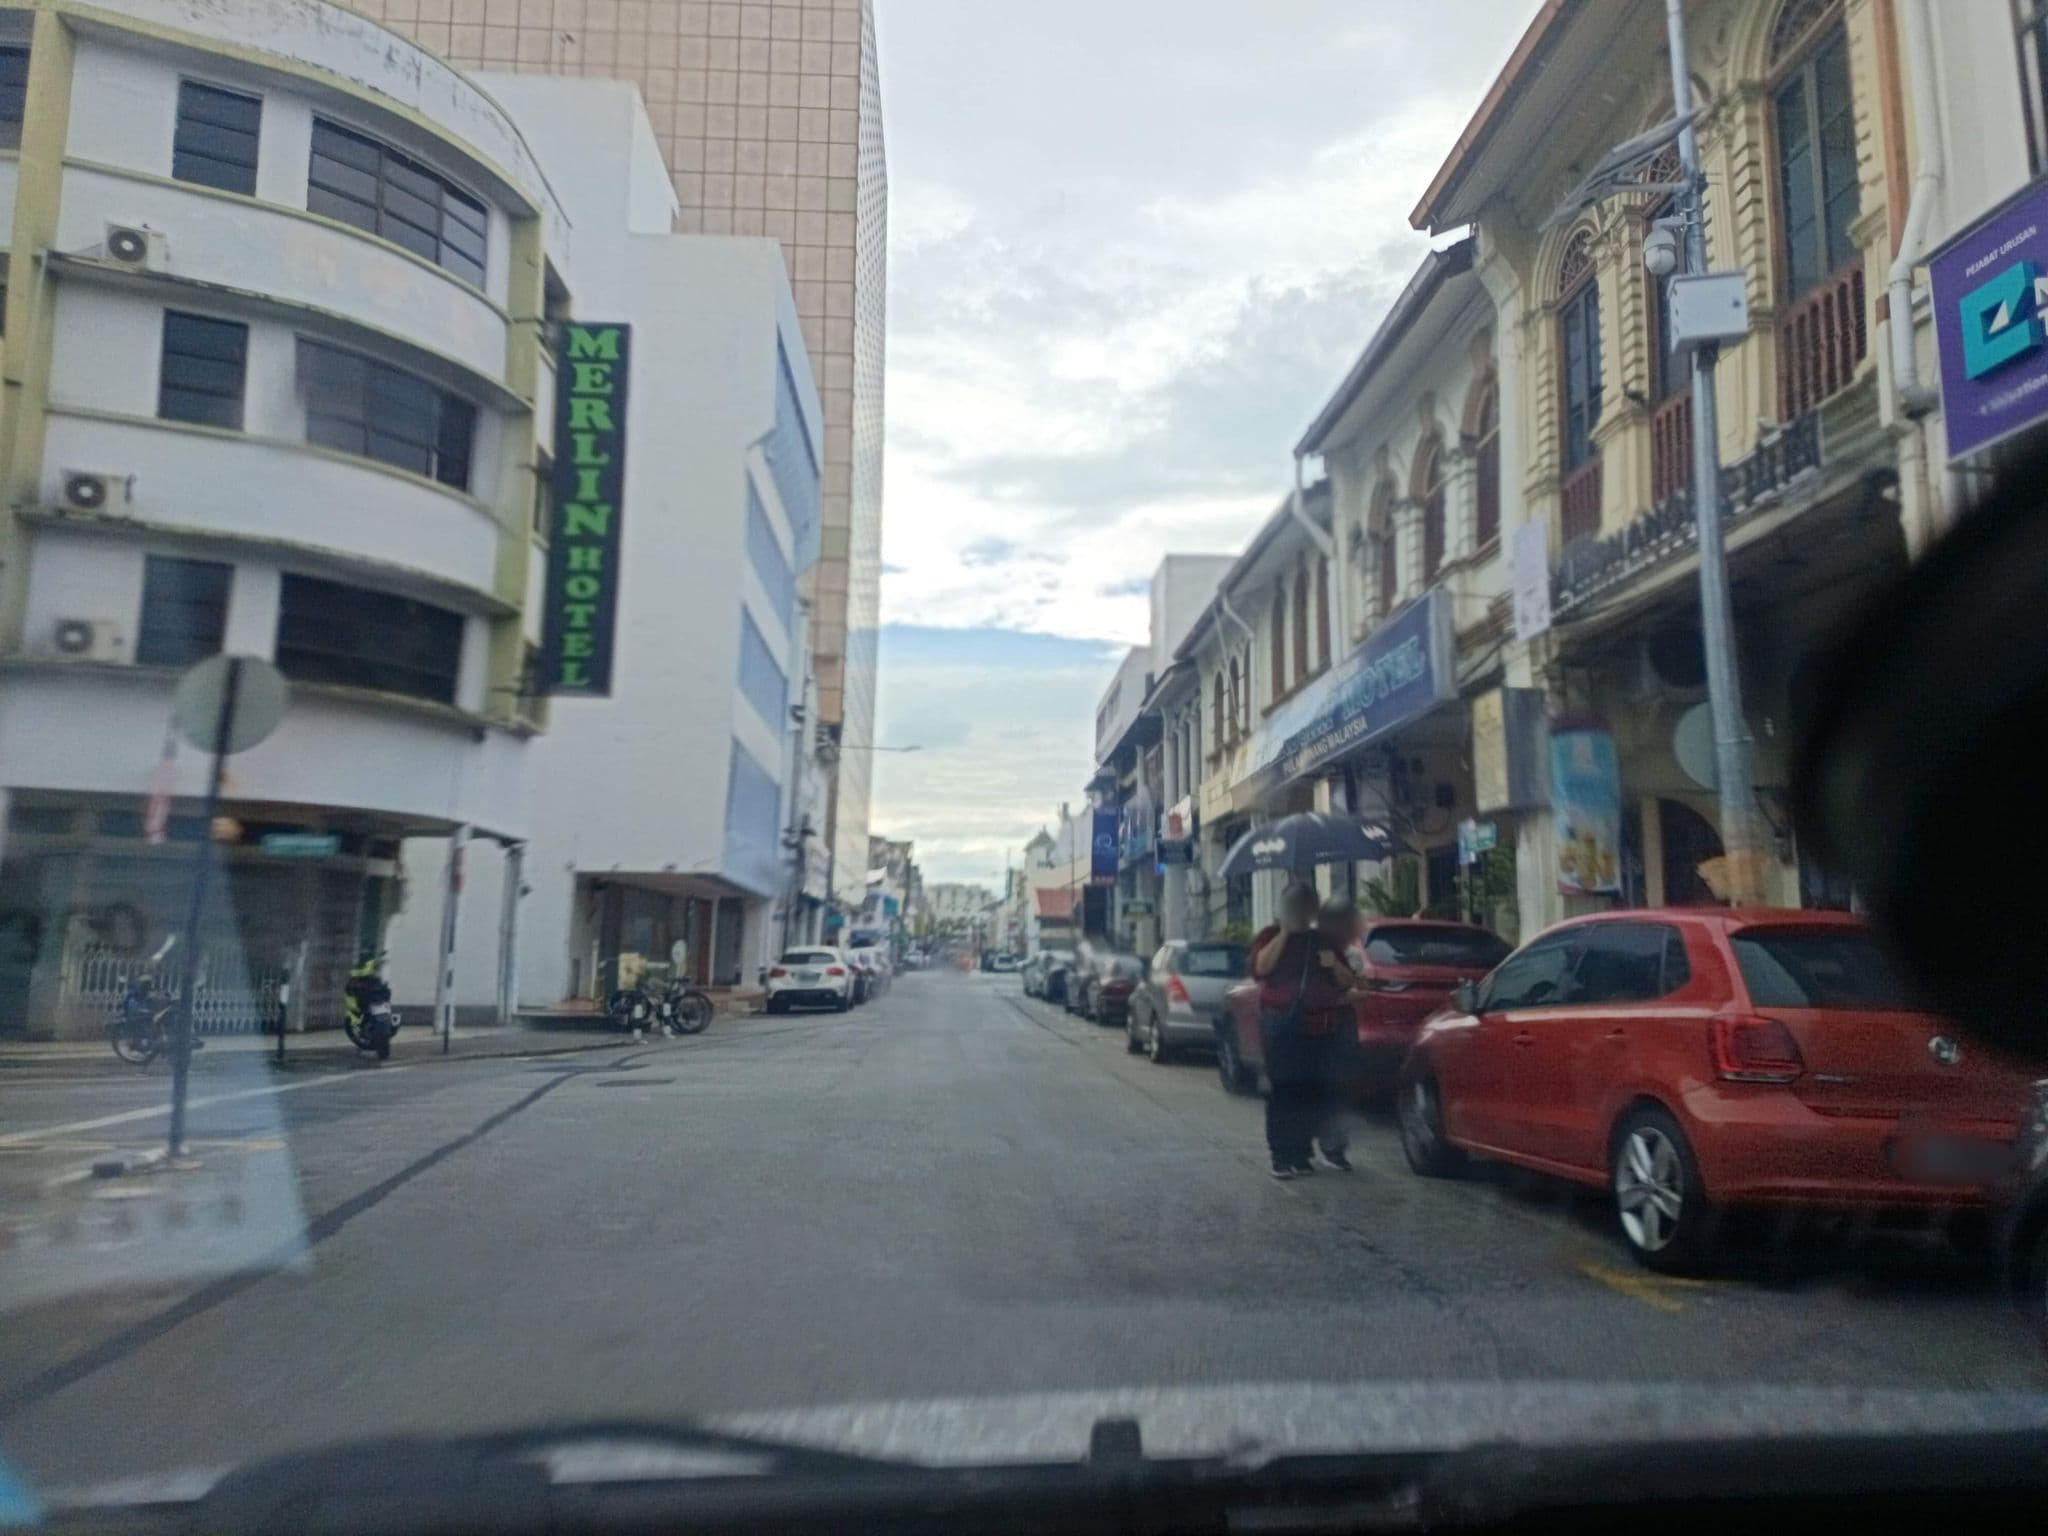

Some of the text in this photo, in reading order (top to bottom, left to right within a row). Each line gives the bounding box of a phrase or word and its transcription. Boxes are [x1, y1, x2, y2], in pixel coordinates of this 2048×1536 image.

[1965, 224, 2037, 279] PEJABAT URUSAN
[560, 327, 621, 687] MERLIN HOTEL
